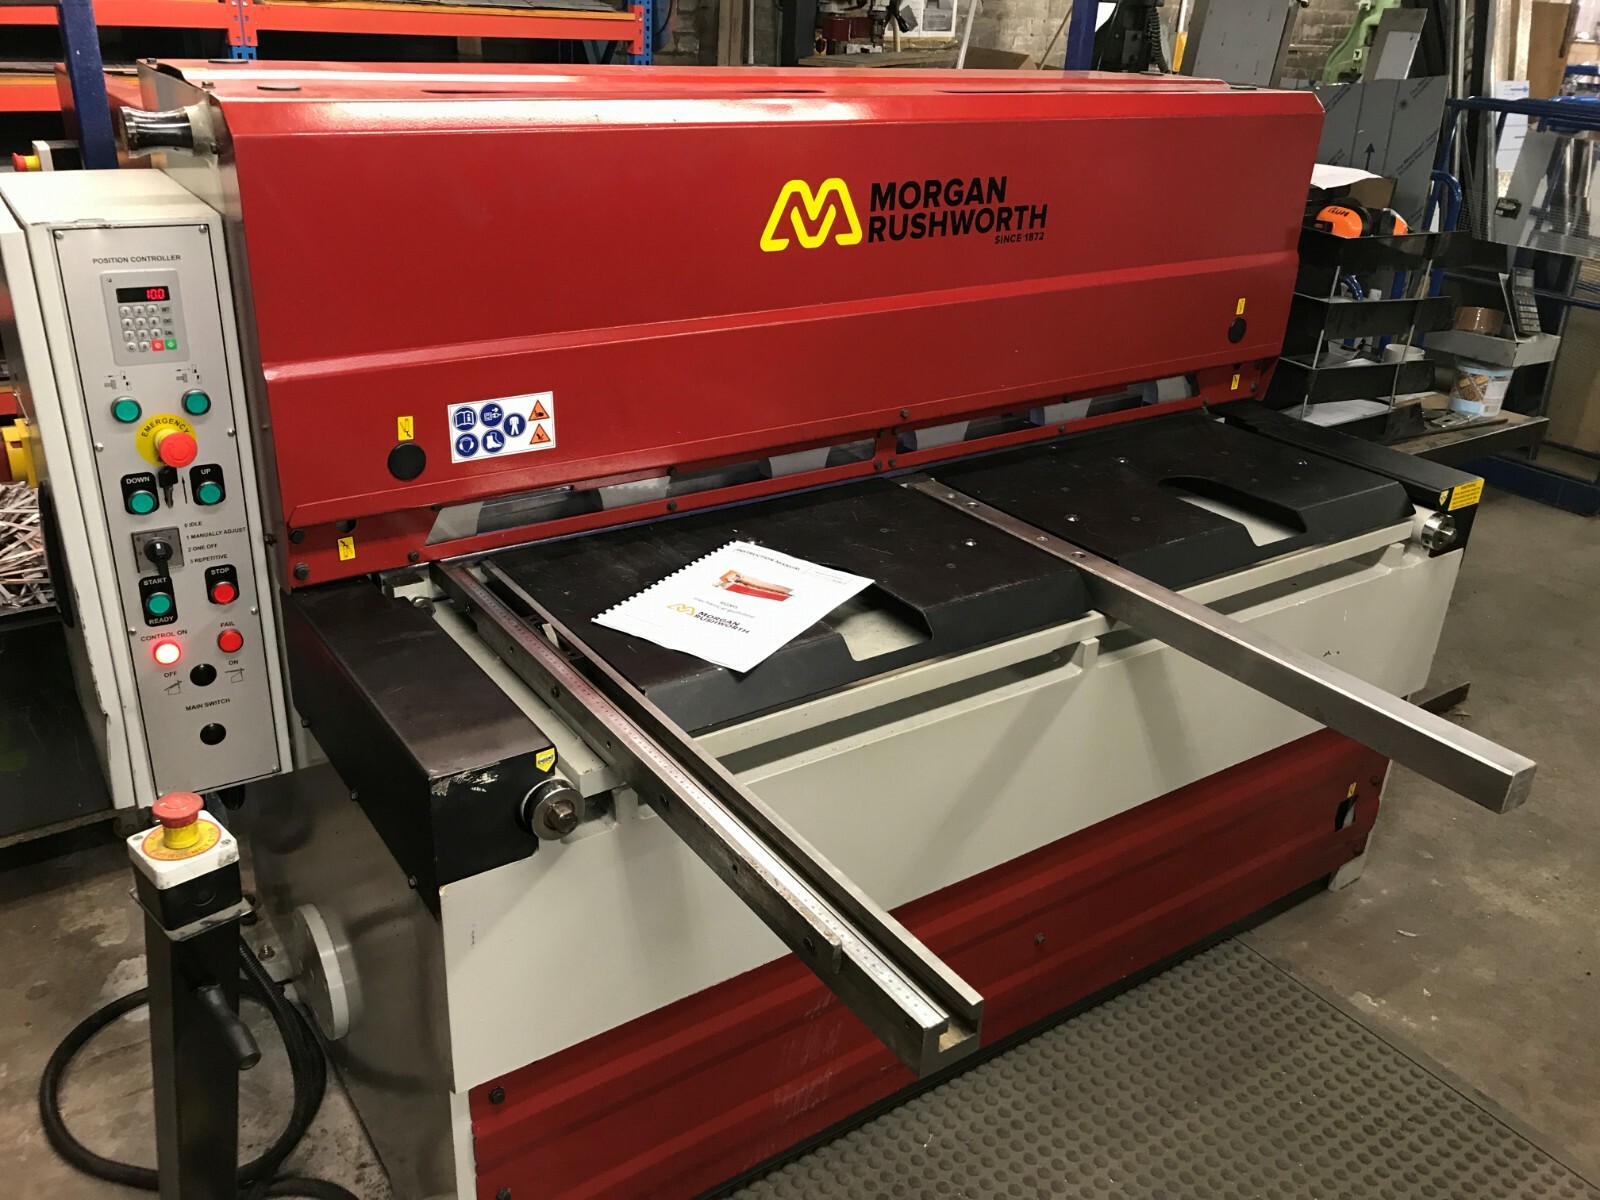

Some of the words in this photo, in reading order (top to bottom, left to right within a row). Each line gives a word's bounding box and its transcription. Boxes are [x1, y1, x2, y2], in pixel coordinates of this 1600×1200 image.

[870, 176, 1007, 212] MORGAN
[868, 204, 1047, 243] RUSHWORTH
[994, 234, 1022, 244] SINCE
[1025, 232, 1044, 242] 1872
[141, 418, 189, 437] EMERGENCY
[126, 476, 150, 484] DOWN
[191, 531, 222, 539] MANUALLY
[194, 554, 227, 563] REPETITIVE
[143, 577, 167, 586] START
[149, 616, 173, 624] READY
[694, 614, 750, 633] RUSHWORTH
[698, 612, 740, 626] MORGAN
[140, 632, 175, 642] CONTROL
[204, 698, 230, 707] SWITCH
